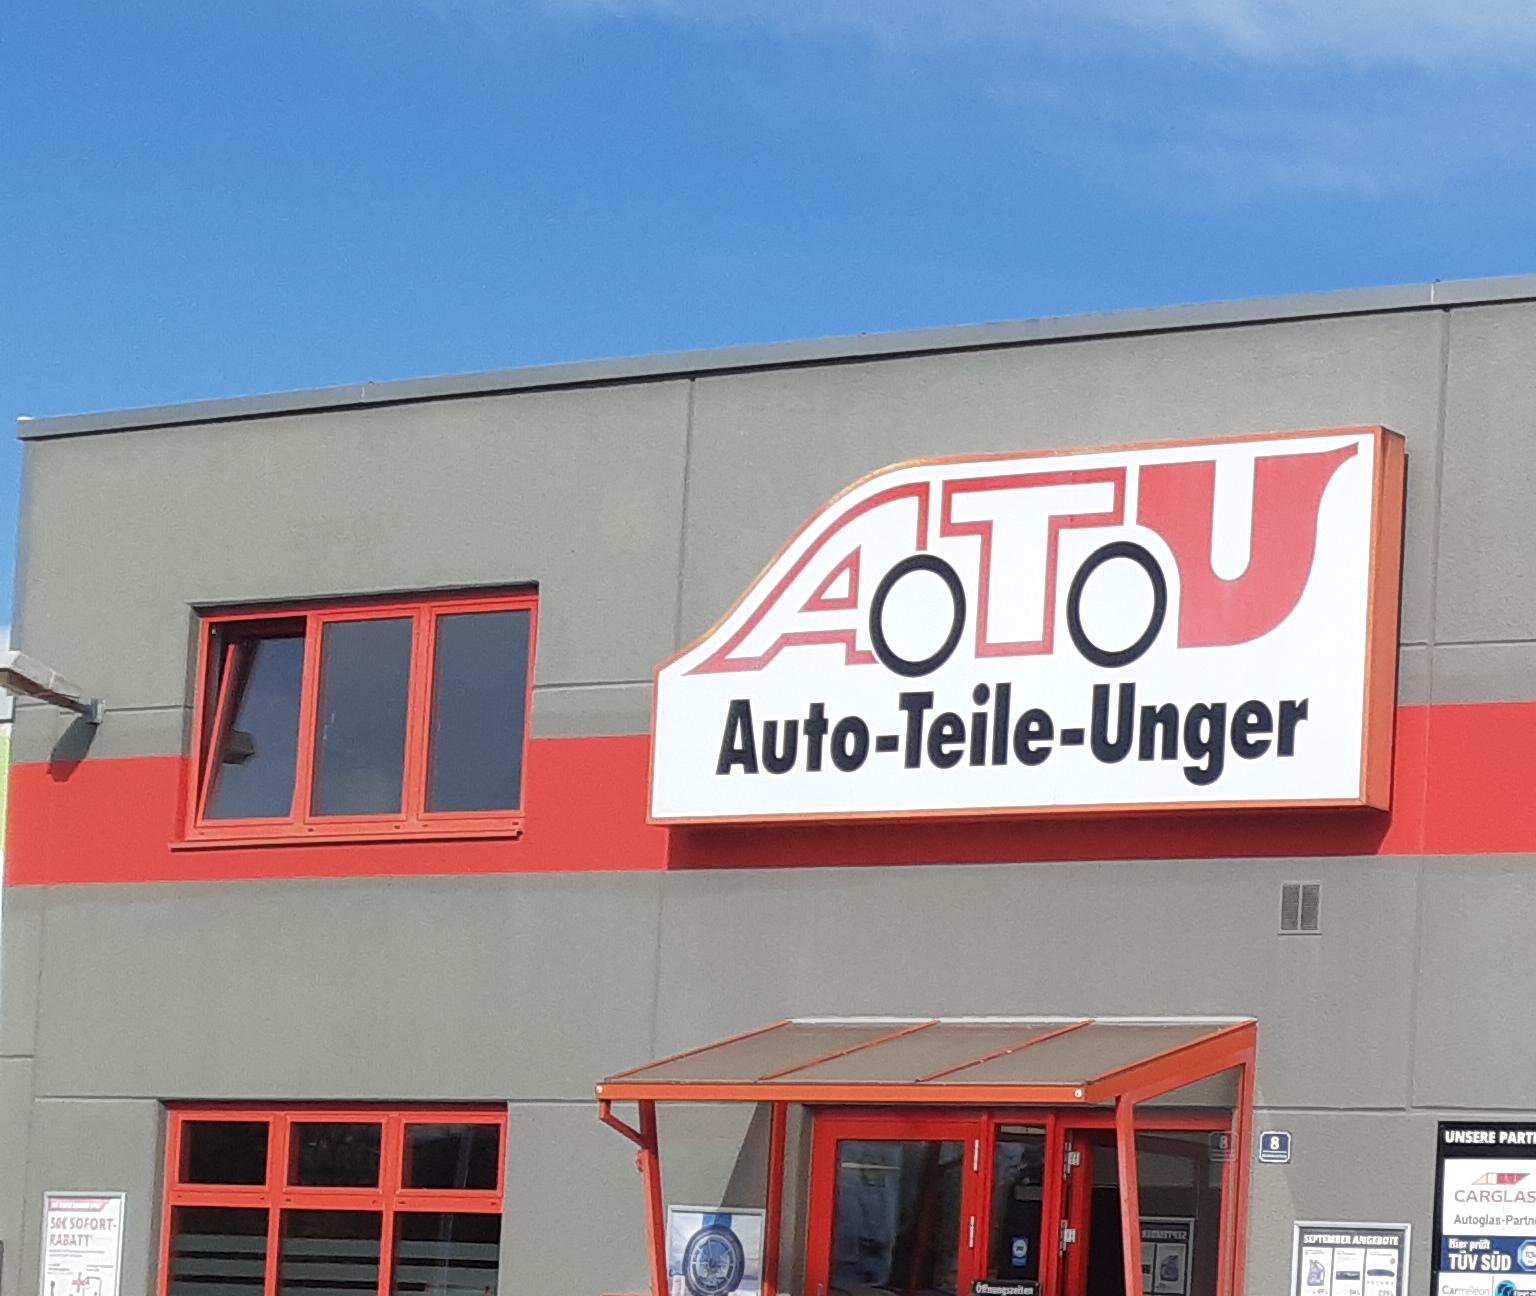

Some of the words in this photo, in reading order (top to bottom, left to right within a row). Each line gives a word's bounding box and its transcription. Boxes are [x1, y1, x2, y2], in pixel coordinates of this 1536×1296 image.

[716, 683, 1309, 785] Auto-Teile-Unger
[1270, 1136, 1280, 1150] 8
[1444, 1130, 1496, 1144] UNSERE
[70, 1216, 117, 1231] SOFORT-
[1303, 1234, 1352, 1244] SEPTEMBER
[1352, 1235, 1399, 1246] ANGEBOTE
[1448, 1250, 1478, 1270] TÜV
[1481, 1251, 1512, 1271] SÜD
